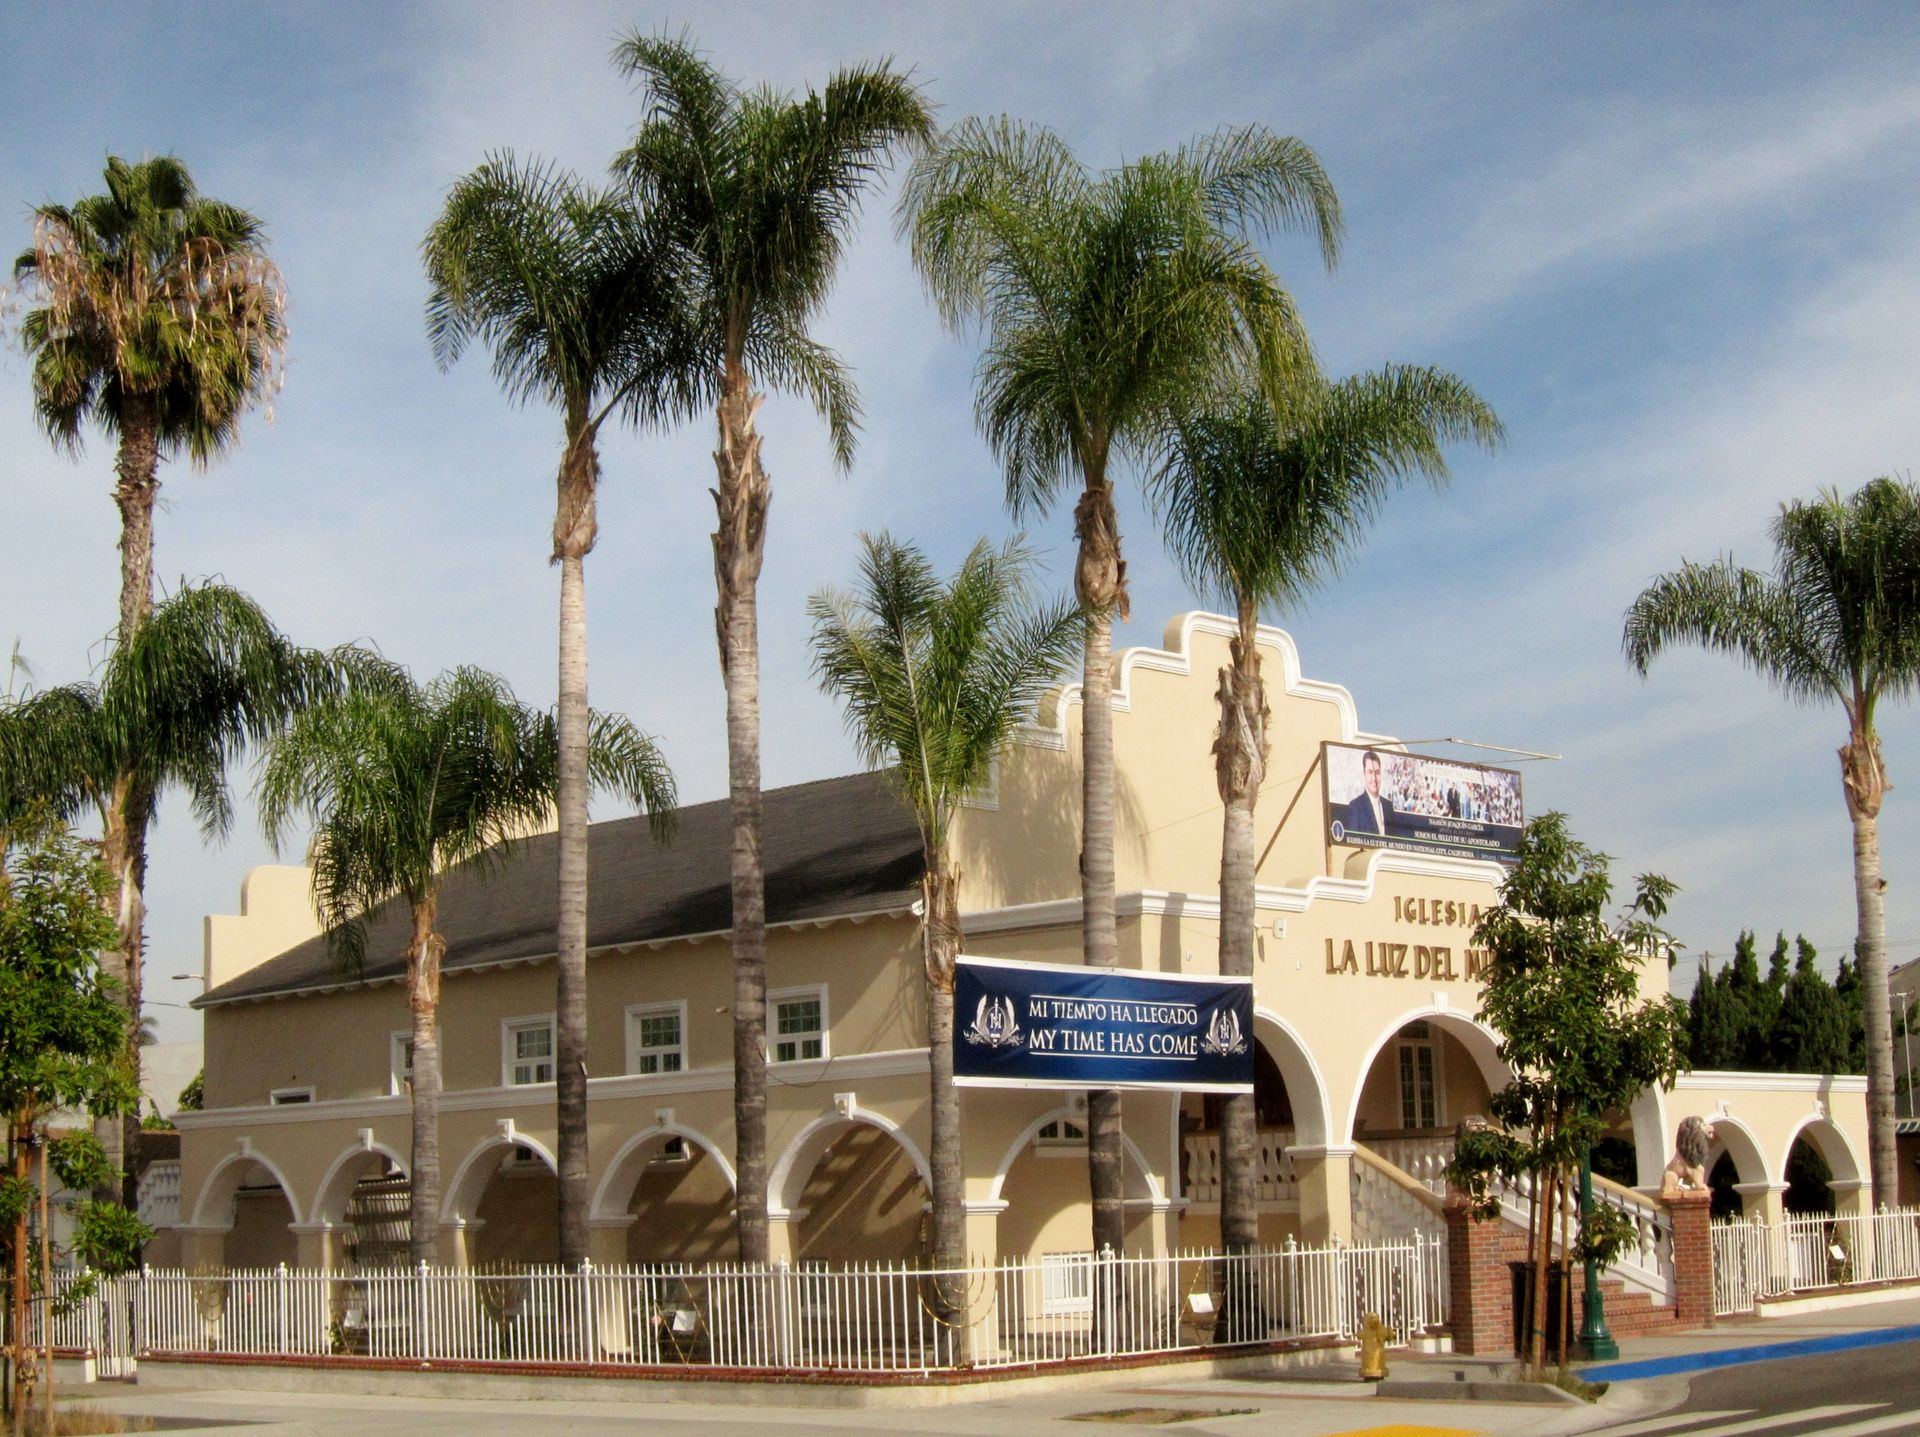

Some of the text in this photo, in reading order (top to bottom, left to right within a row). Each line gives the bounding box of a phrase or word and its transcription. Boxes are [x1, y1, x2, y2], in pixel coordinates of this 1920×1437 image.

[1394, 896, 1482, 928] IGLESIA
[1325, 938, 1359, 975] LA
[1365, 941, 1409, 978] LUZ
[1413, 945, 1459, 981] DEL
[1029, 1000, 1198, 1025] MI TIEMPO HA LLEGADO
[1029, 1028, 1198, 1055] MY TIME HAS COME
